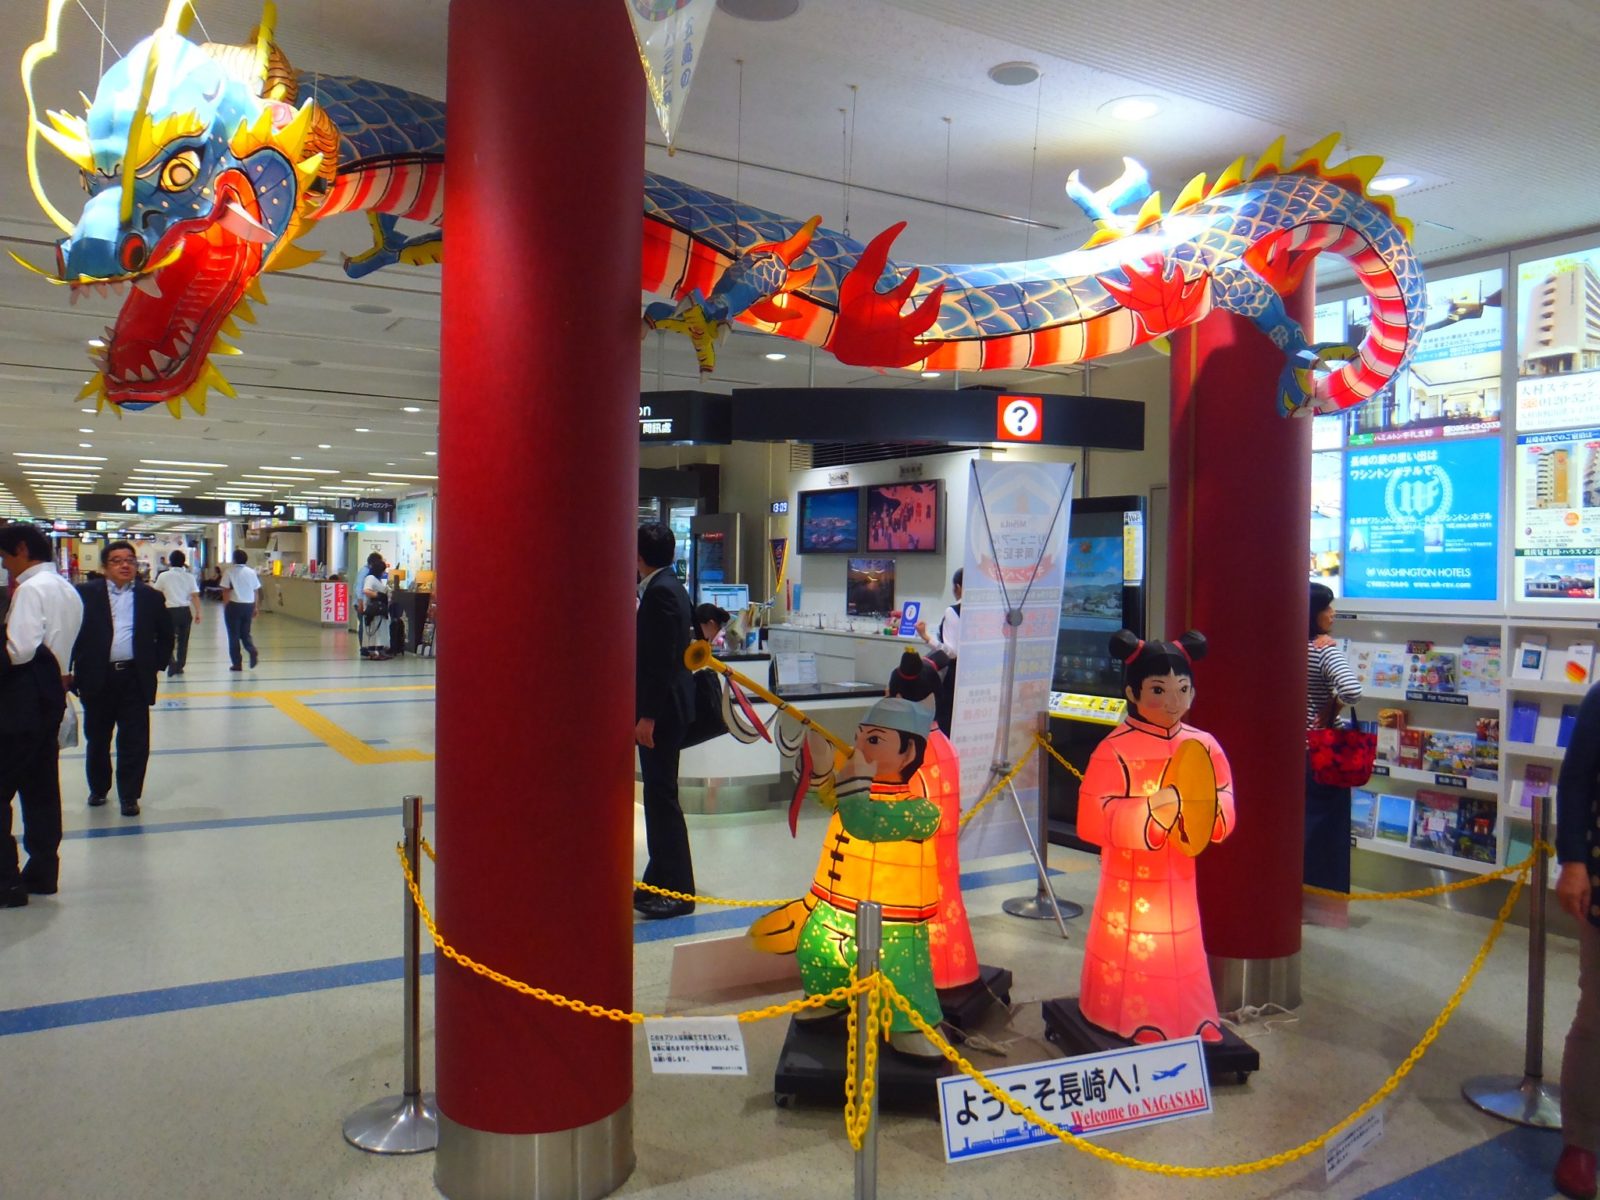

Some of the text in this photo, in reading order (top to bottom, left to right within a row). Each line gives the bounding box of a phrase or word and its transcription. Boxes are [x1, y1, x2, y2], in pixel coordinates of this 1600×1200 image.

[1377, 567, 1472, 577] WASHINGTON HOTELS
[323, 583, 333, 620] レンタカー
[1071, 1088, 1205, 1127] Welcome to NAGASAKI
